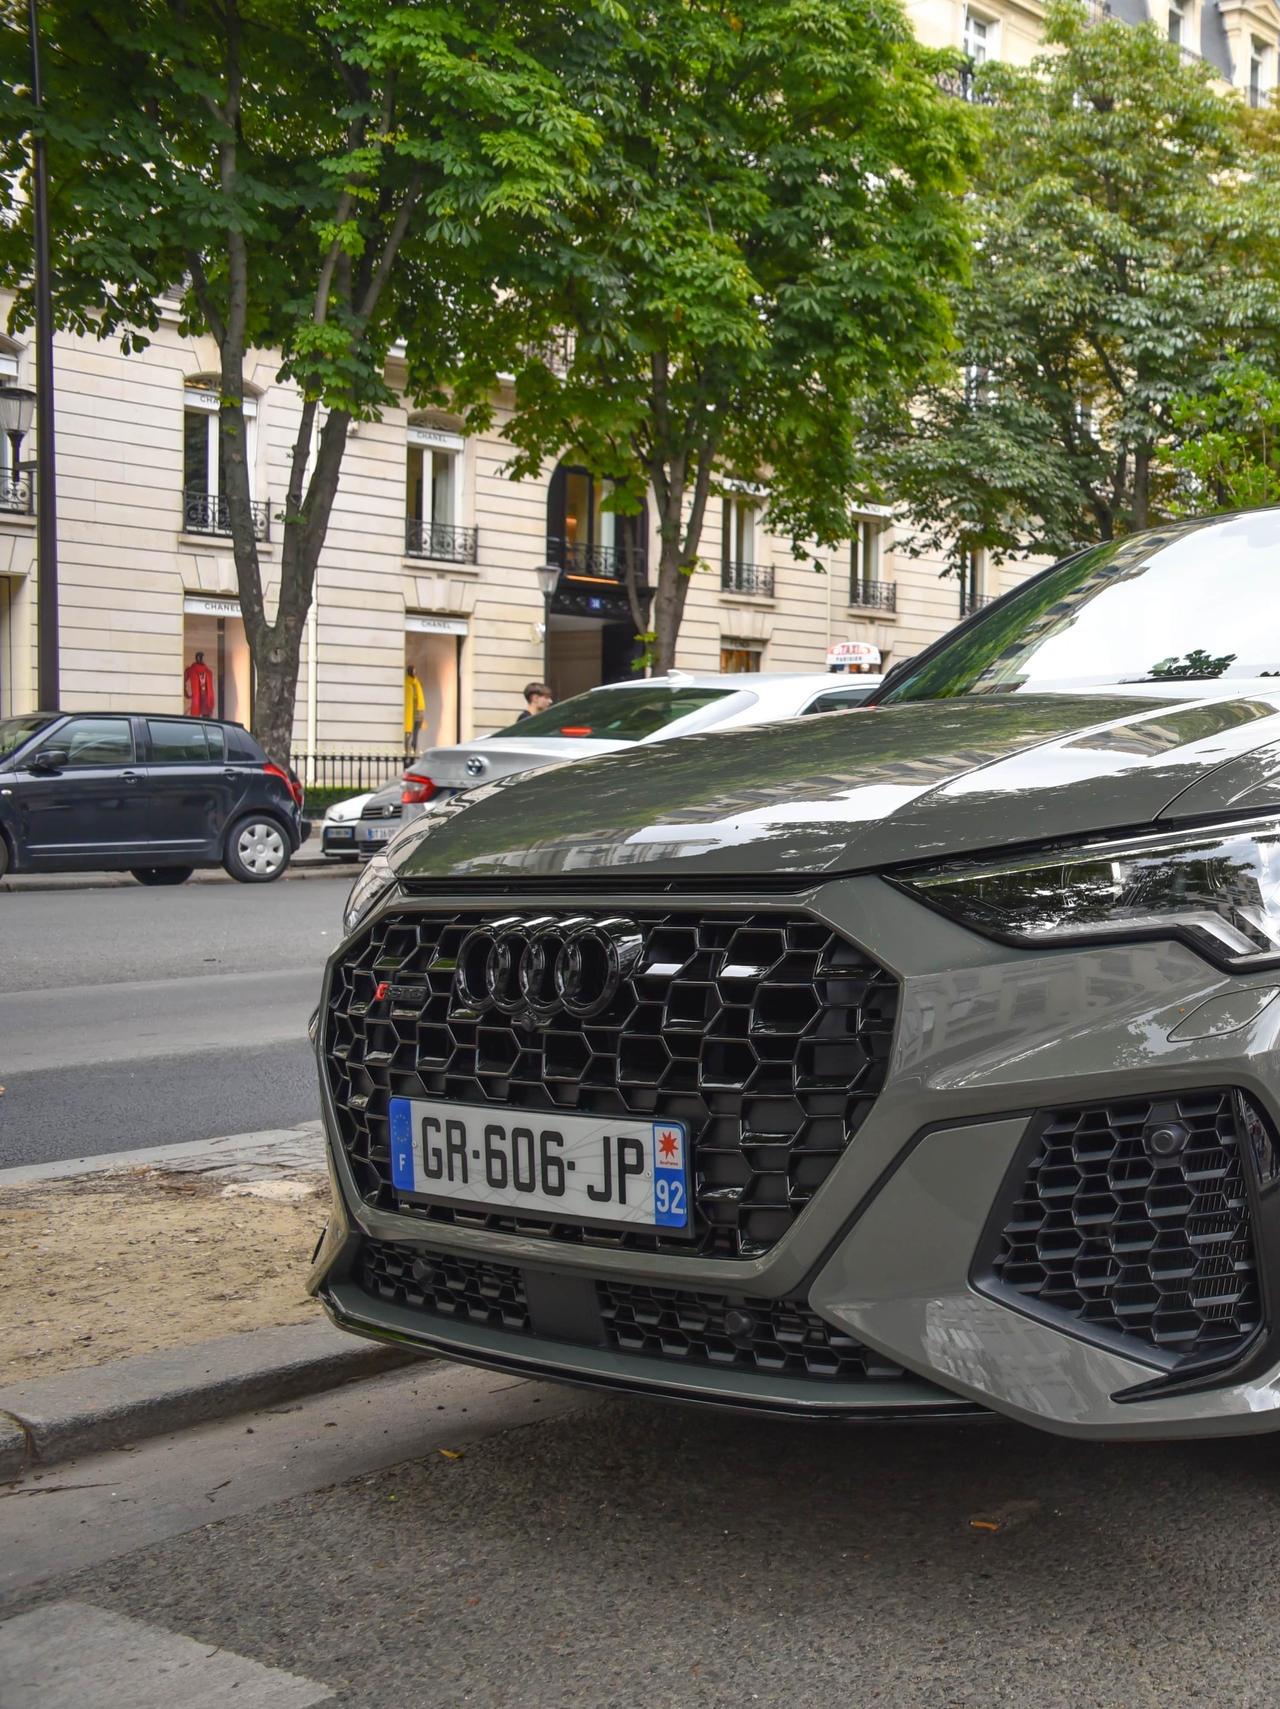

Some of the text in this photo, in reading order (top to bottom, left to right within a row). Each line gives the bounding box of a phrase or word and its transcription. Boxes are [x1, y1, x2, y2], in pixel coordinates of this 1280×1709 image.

[416, 431, 447, 443] CHANEL
[204, 602, 241, 613] CHANEL
[421, 620, 451, 630] CHANEL
[841, 644, 860, 655] TAXI
[399, 1153, 406, 1171] F
[656, 1179, 684, 1214] 92
